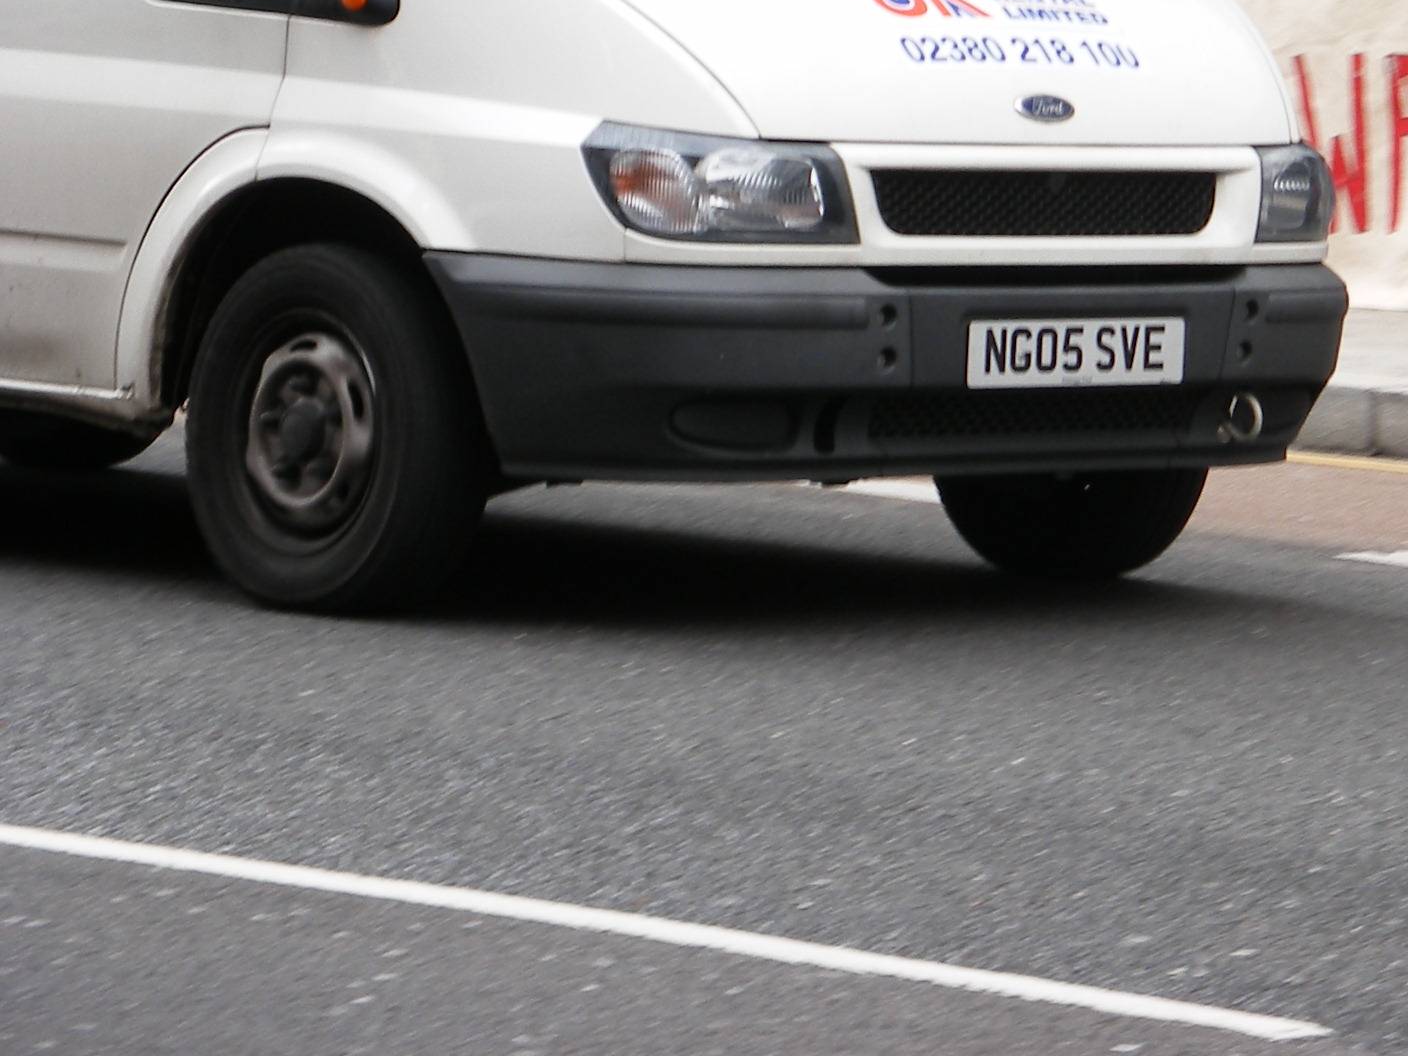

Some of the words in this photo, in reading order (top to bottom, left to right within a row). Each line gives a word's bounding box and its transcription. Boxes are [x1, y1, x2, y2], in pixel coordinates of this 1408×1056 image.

[1002, 6, 1108, 25] LIMITED
[900, 37, 1006, 63] 02380
[1011, 37, 1075, 64] 218
[1081, 40, 1140, 69] 100
[984, 325, 1084, 375] NG05
[1096, 324, 1166, 372] SVE
